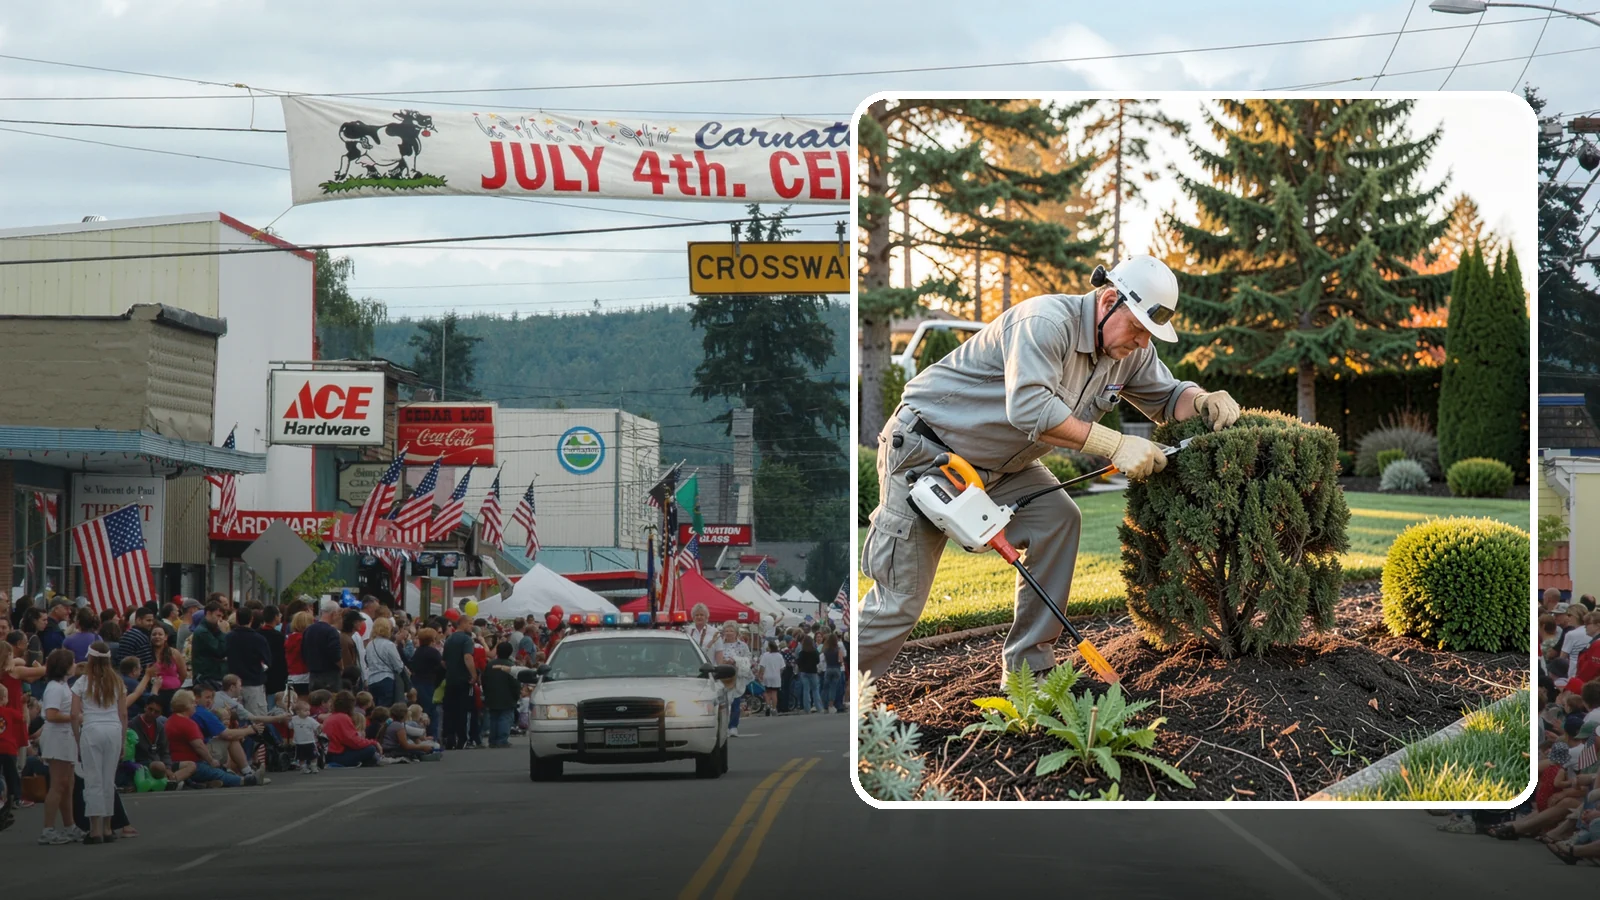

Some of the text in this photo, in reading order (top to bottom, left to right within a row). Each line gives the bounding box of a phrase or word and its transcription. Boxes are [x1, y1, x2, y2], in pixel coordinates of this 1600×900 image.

[481, 141, 605, 191] JULY
[632, 149, 746, 198] 4th.
[697, 254, 850, 280] CROSSWA
[283, 380, 373, 420] ACE
[406, 409, 485, 421] CEDAR LOG
[283, 421, 371, 437] Hardware
[416, 428, 477, 447] Coca-Cola
[353, 467, 386, 480] Simpl
[96, 485, 124, 495] Vincent
[126, 486, 136, 495] de
[137, 486, 155, 495] Paul
[212, 515, 331, 535] HARDARE
[688, 526, 742, 535] CRNATION
[699, 535, 730, 543] GLASS
